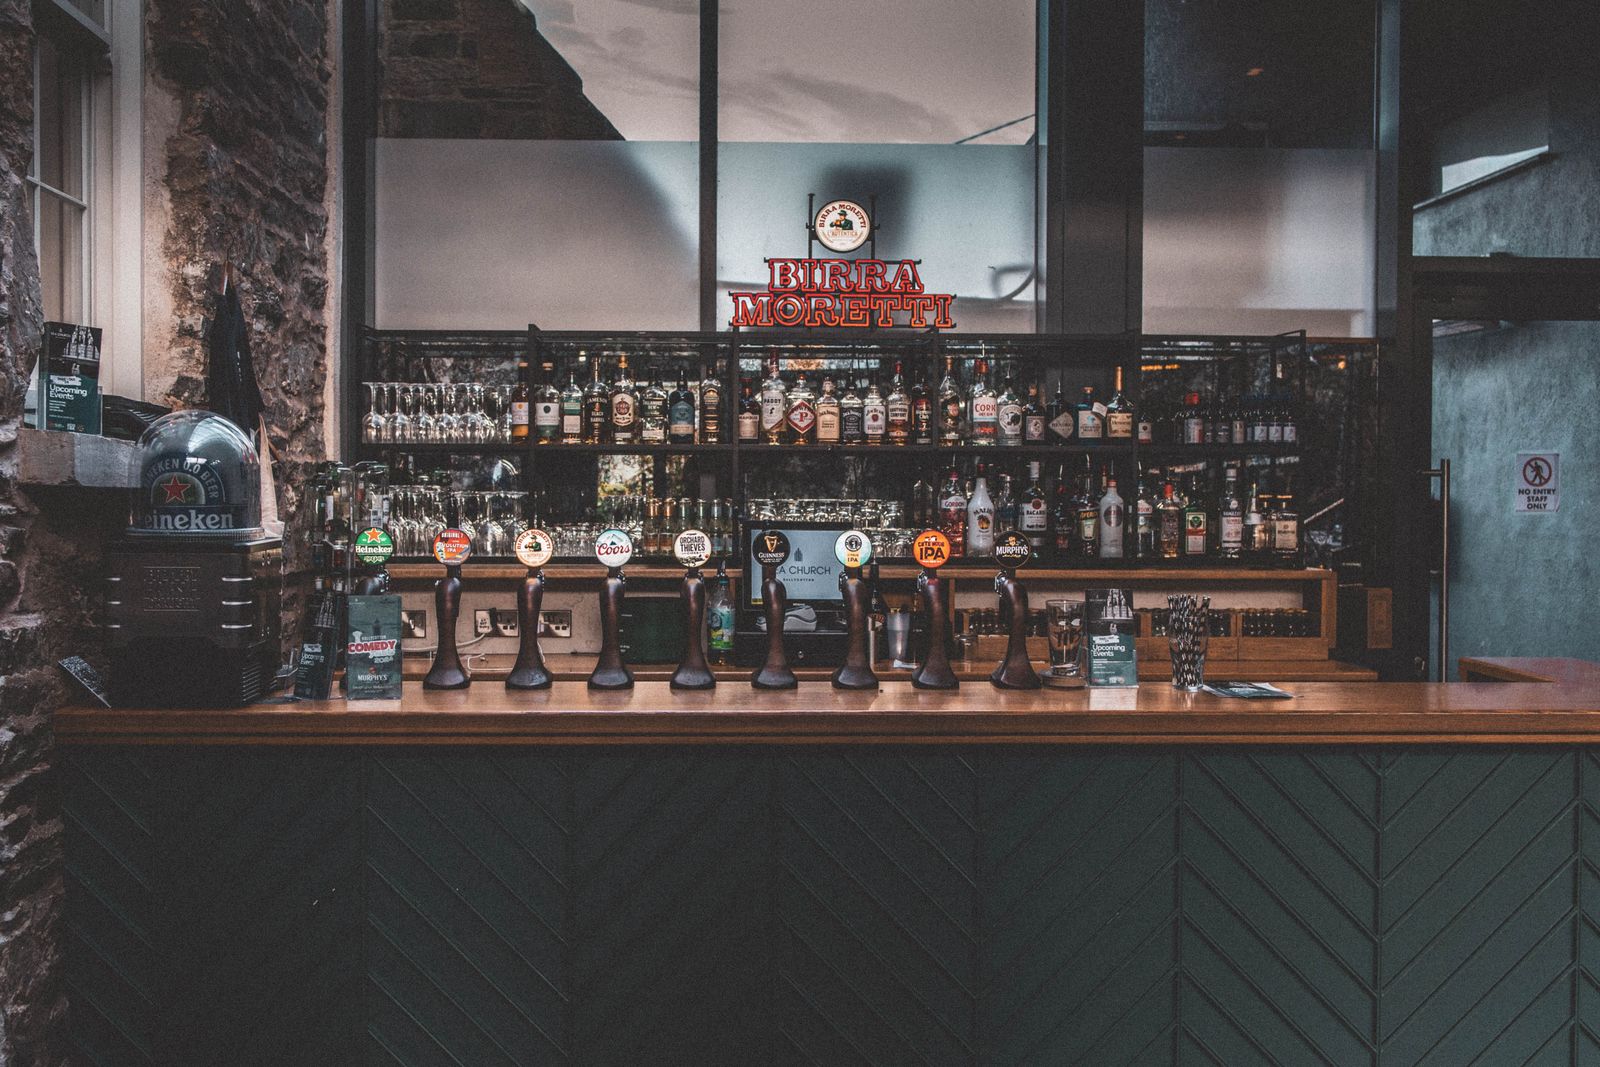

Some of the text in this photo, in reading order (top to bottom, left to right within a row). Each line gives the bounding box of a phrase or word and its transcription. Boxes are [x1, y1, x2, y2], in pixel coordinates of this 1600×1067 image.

[819, 204, 866, 228] BIRRA MORETTI
[768, 258, 924, 293] BIRRA
[733, 293, 953, 328] MORETTI
[50, 385, 87, 397] Upcoming
[50, 391, 74, 401] Events
[975, 404, 996, 412] CORK
[799, 412, 808, 422] P
[183, 460, 200, 473] 0.0
[201, 470, 224, 498] BEER
[145, 509, 234, 529] eineken
[356, 545, 392, 553] Heineken
[598, 543, 630, 555] Coors
[681, 544, 705, 552] THIEVES
[920, 547, 946, 560] IPA
[996, 545, 1028, 555] MURPHY'S
[789, 566, 831, 575] CHURCH
[348, 641, 396, 653] COMEDY
